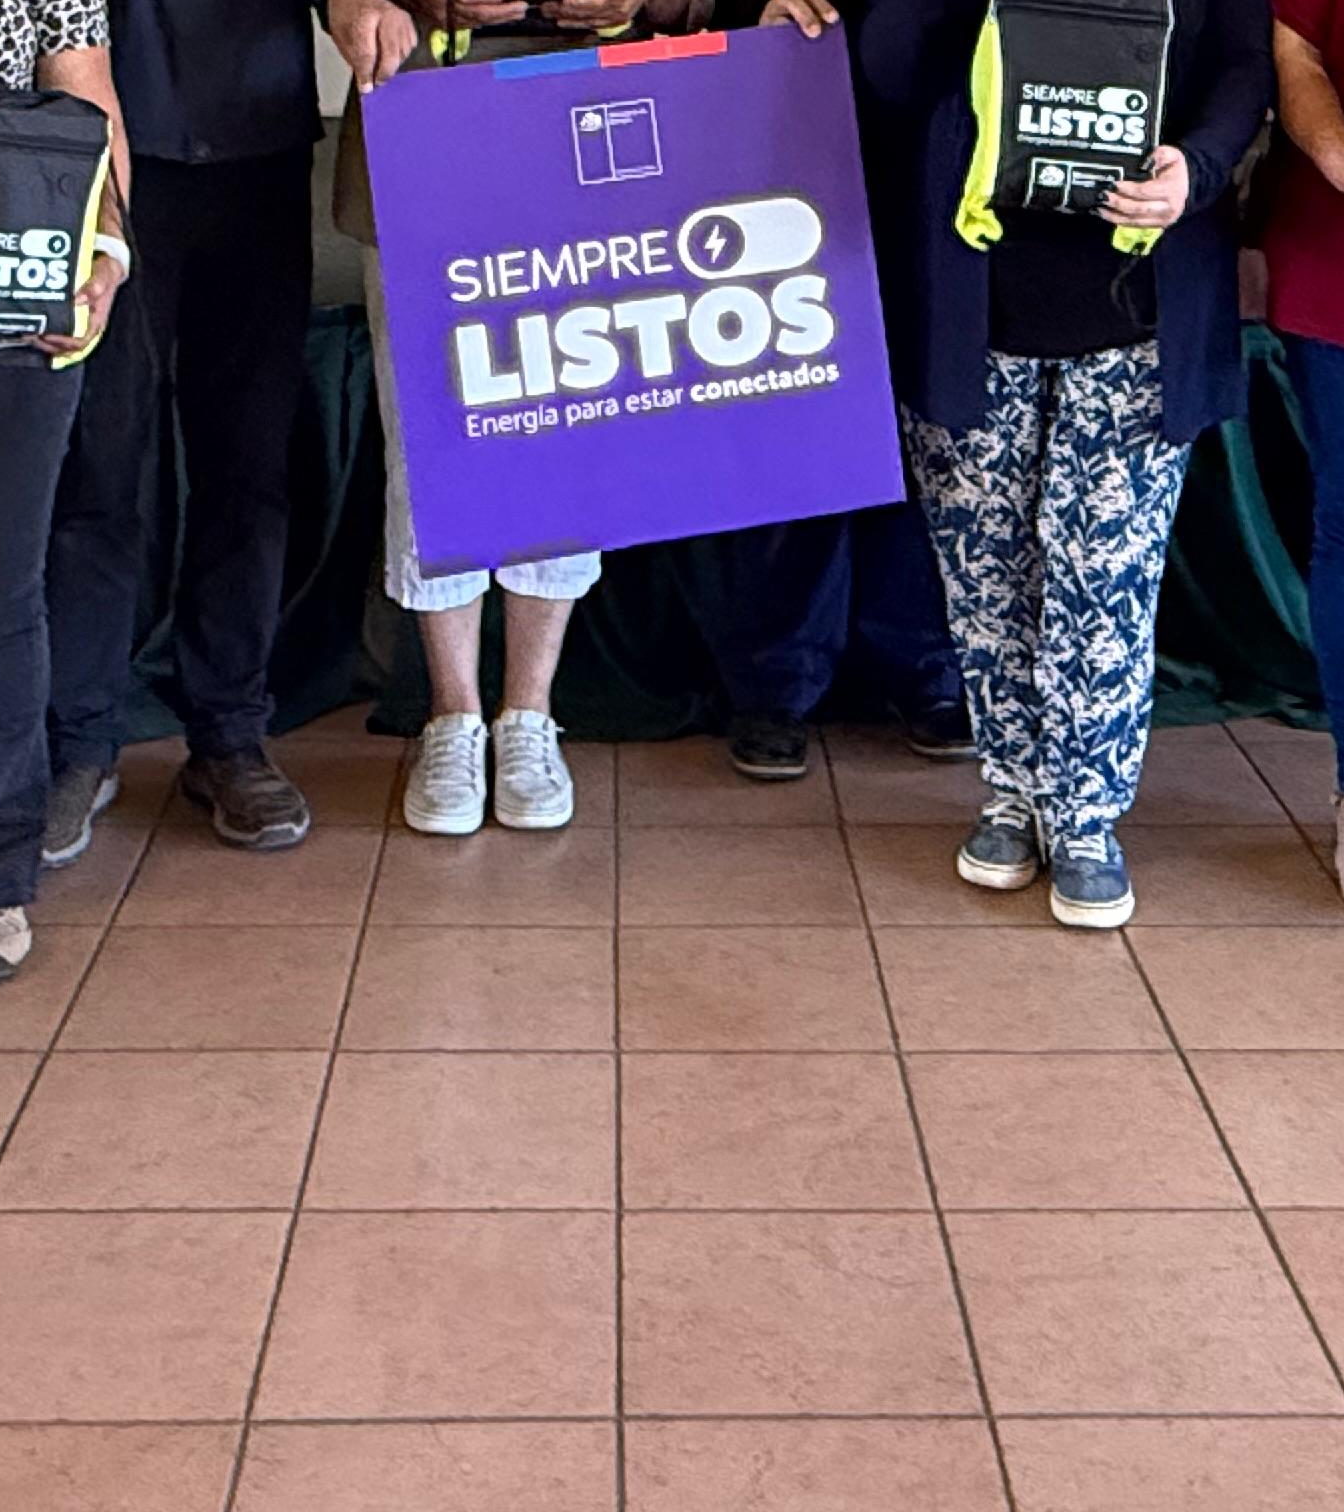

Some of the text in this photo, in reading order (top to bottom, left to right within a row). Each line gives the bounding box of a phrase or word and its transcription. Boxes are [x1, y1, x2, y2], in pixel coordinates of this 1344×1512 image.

[1018, 104, 1147, 145] LISTOS
[1022, 82, 1098, 106] SIEMPRE
[448, 229, 674, 302] SIEMPRE
[456, 275, 835, 406] LISTOS
[566, 397, 619, 427] para
[626, 386, 684, 414] estar
[690, 362, 840, 402] conectados
